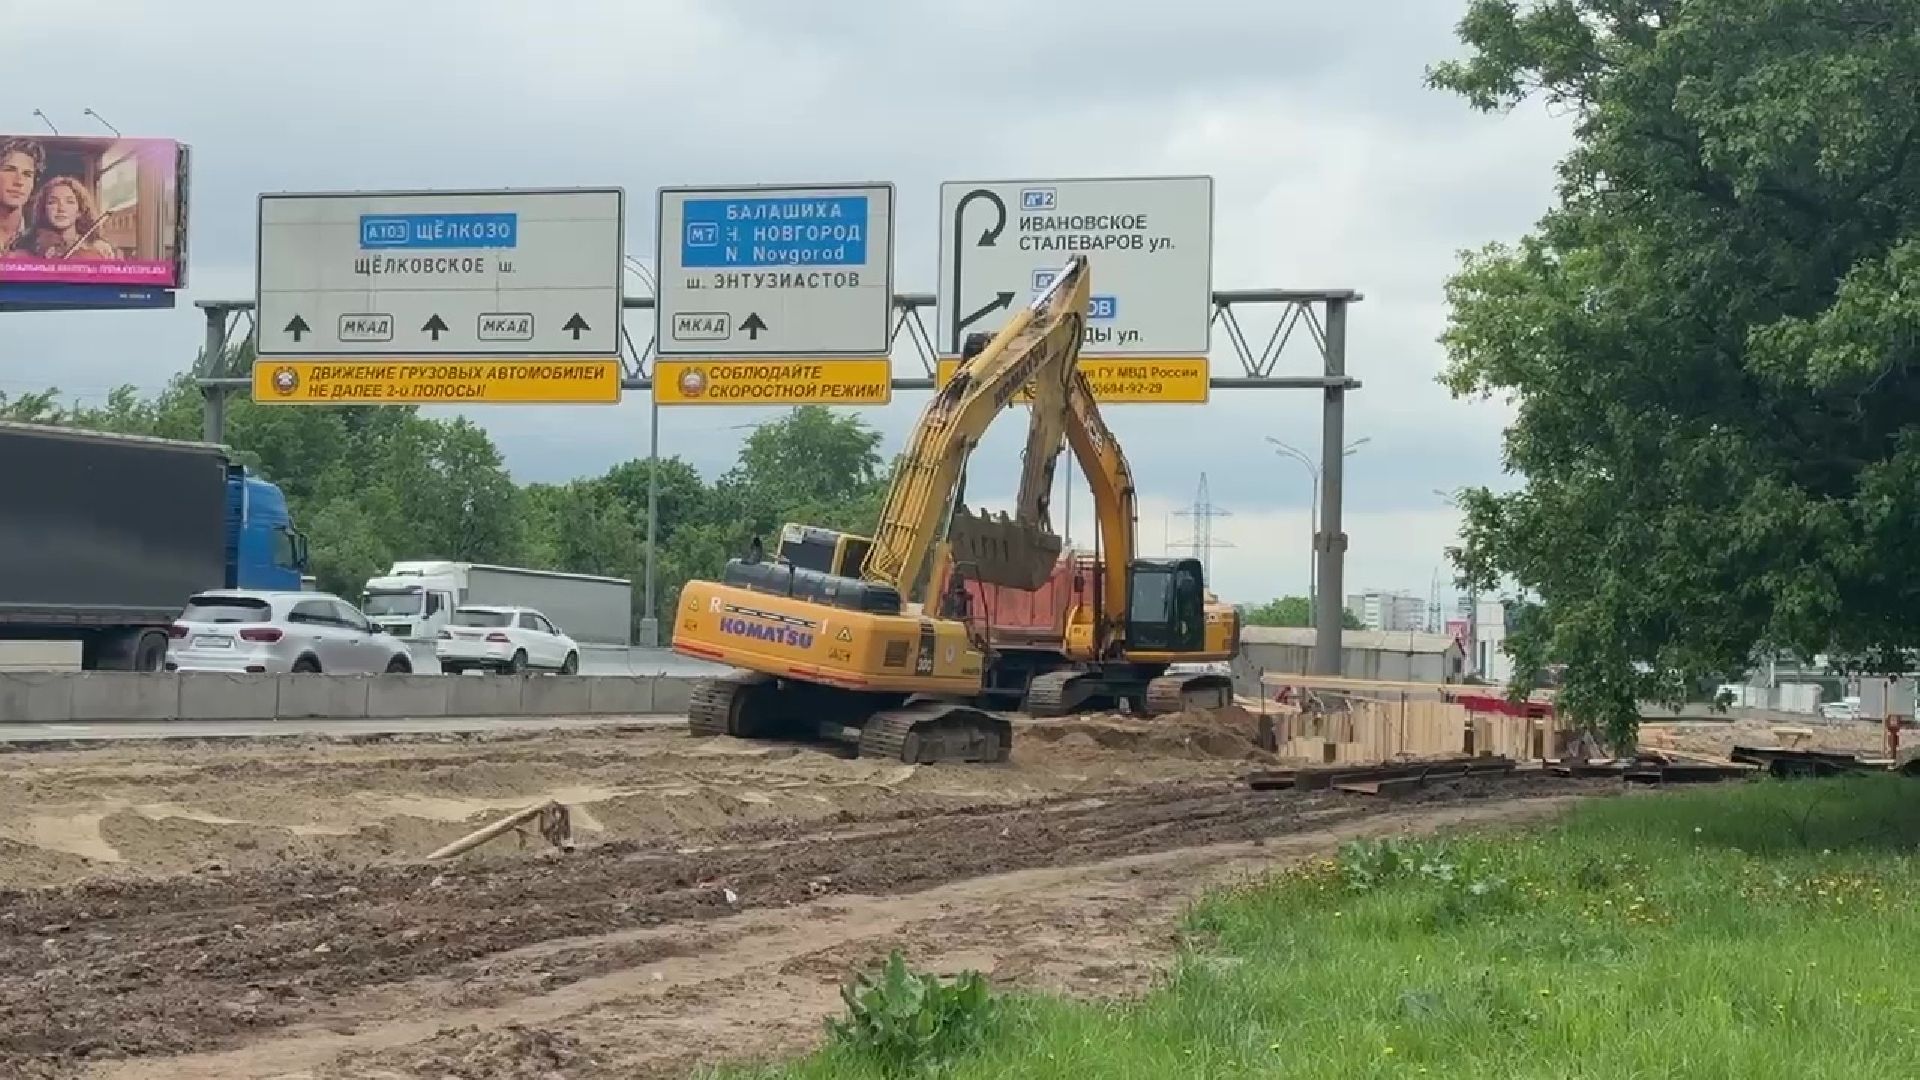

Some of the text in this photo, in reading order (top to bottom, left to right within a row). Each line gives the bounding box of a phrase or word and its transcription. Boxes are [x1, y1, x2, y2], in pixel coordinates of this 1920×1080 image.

[726, 201, 841, 220] БАЛАШИХА
[1019, 214, 1147, 231] ИВАНОВСКОЕ
[691, 227, 715, 242] М7
[753, 224, 861, 242] НОВГОРОД
[1019, 234, 1175, 253] СТАЛЕВАРОВ ул.
[753, 244, 844, 265] Novgorod
[354, 254, 517, 276] ЩЁЛКОВСКОЕ ш.
[686, 272, 860, 289] ш. ЭНТУЗИАСТОВ
[343, 319, 389, 335] МКАД
[483, 318, 529, 335] МКАД
[678, 318, 725, 334] МКАД
[1117, 329, 1144, 345] ул.
[308, 366, 396, 381] ДВИЖЕНИЕ
[399, 366, 484, 380] ГРУЗОВЫХ
[709, 364, 823, 381] СОБЛЮДАЙТЕ
[1098, 366, 1114, 378] ГУ
[1117, 366, 1147, 379] МВД
[1151, 366, 1198, 378] России
[308, 384, 328, 397] НЕ
[331, 384, 382, 399] ДАЛЕЕ
[411, 383, 487, 398] ПОЛОСЫ!
[709, 382, 885, 398] СКОРОСТНОЙ РЕЖИМ!
[719, 616, 814, 649] KOMATSU
